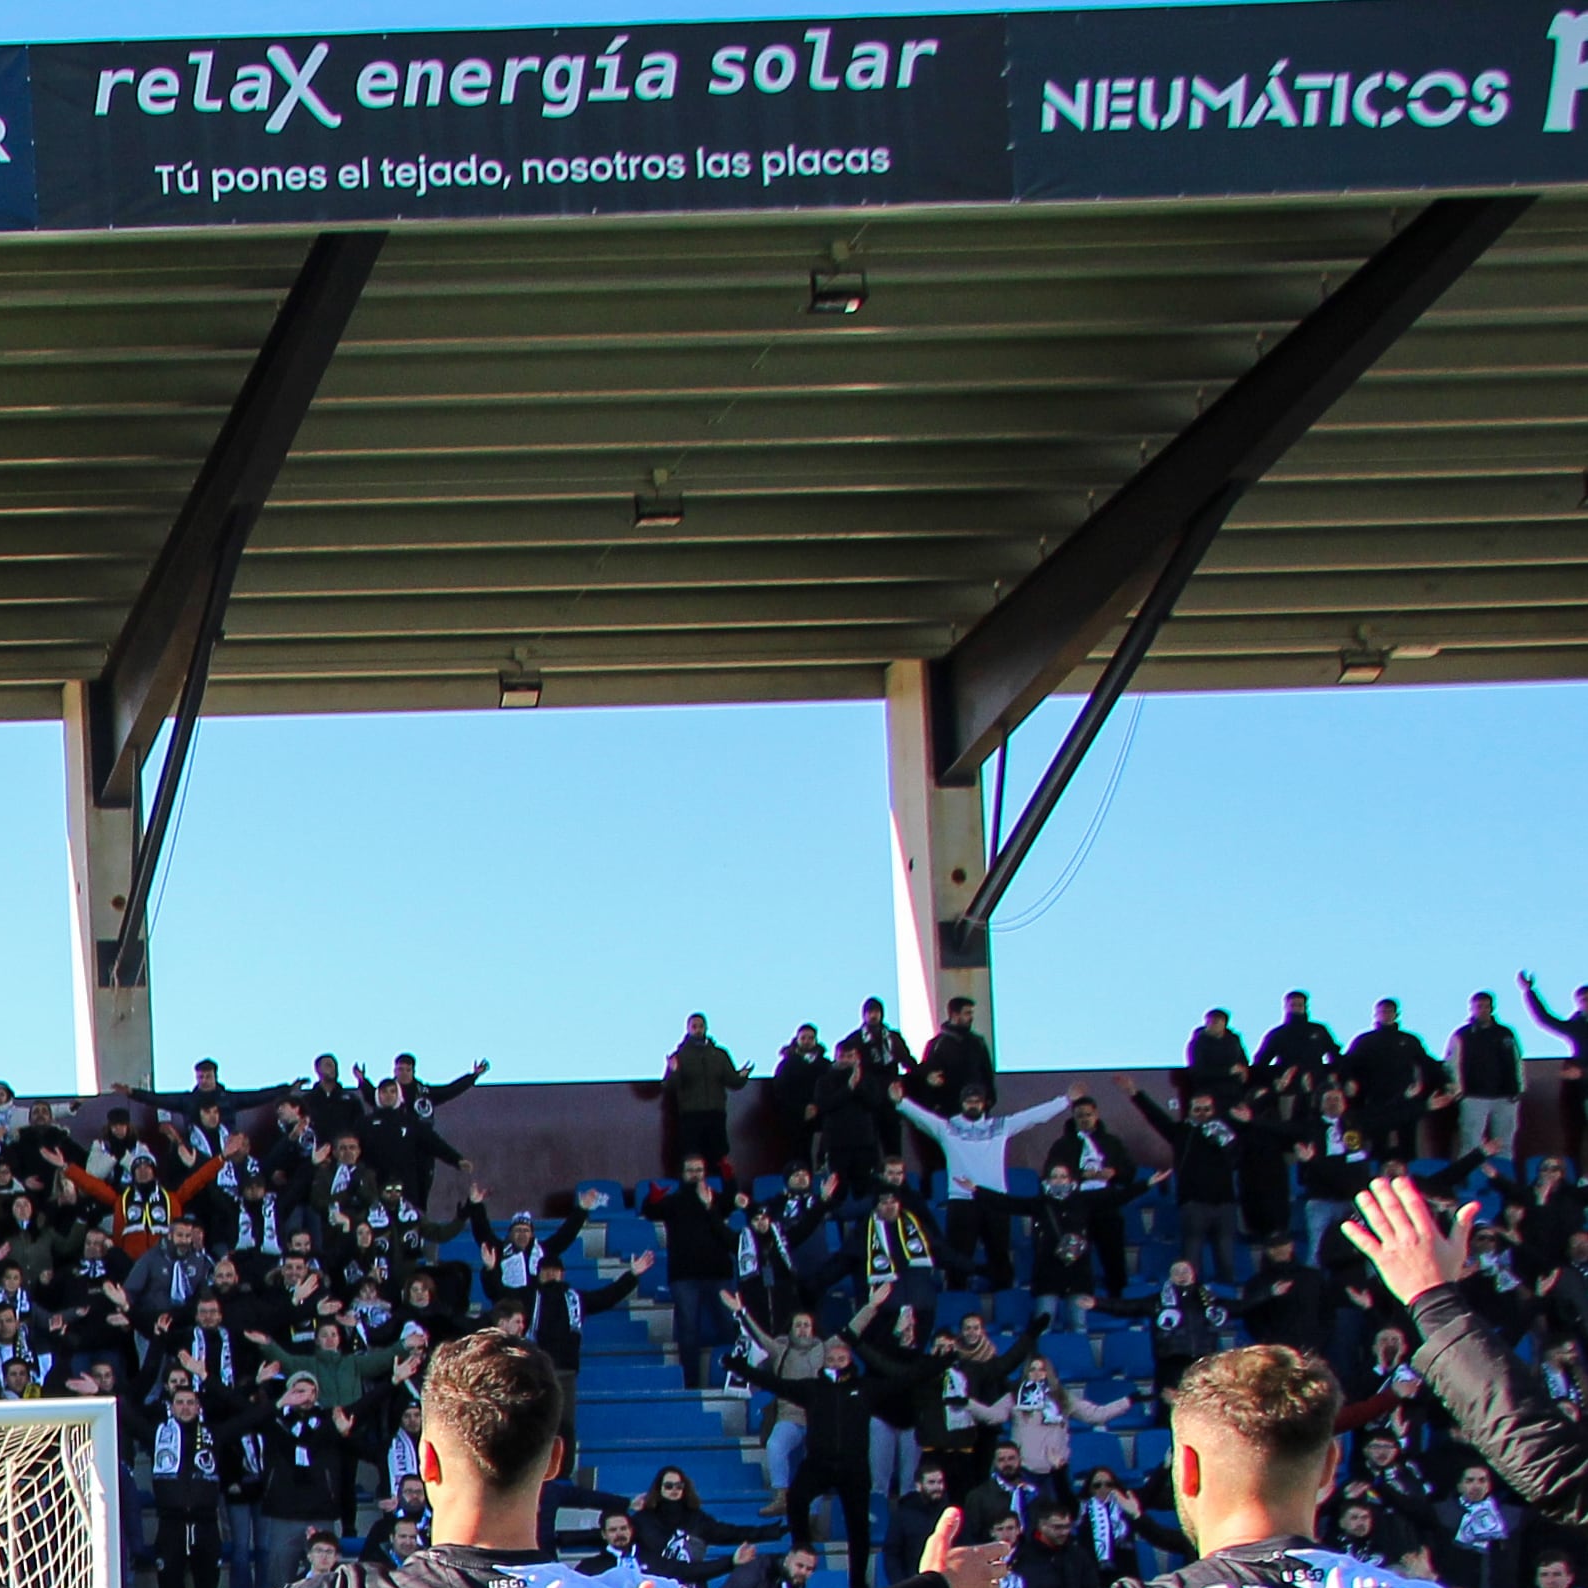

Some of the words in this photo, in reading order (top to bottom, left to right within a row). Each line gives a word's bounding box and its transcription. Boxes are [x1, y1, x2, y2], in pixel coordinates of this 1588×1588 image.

[355, 35, 678, 119] energía
[708, 29, 939, 96] solar
[1040, 57, 1511, 132] NEUMÁTICOS
[154, 162, 199, 195] Tú
[212, 160, 328, 201] pones
[338, 156, 369, 190] el
[380, 154, 511, 199] tejado,
[521, 150, 686, 186] nosotros
[695, 146, 750, 180] las
[761, 142, 891, 185] placas
